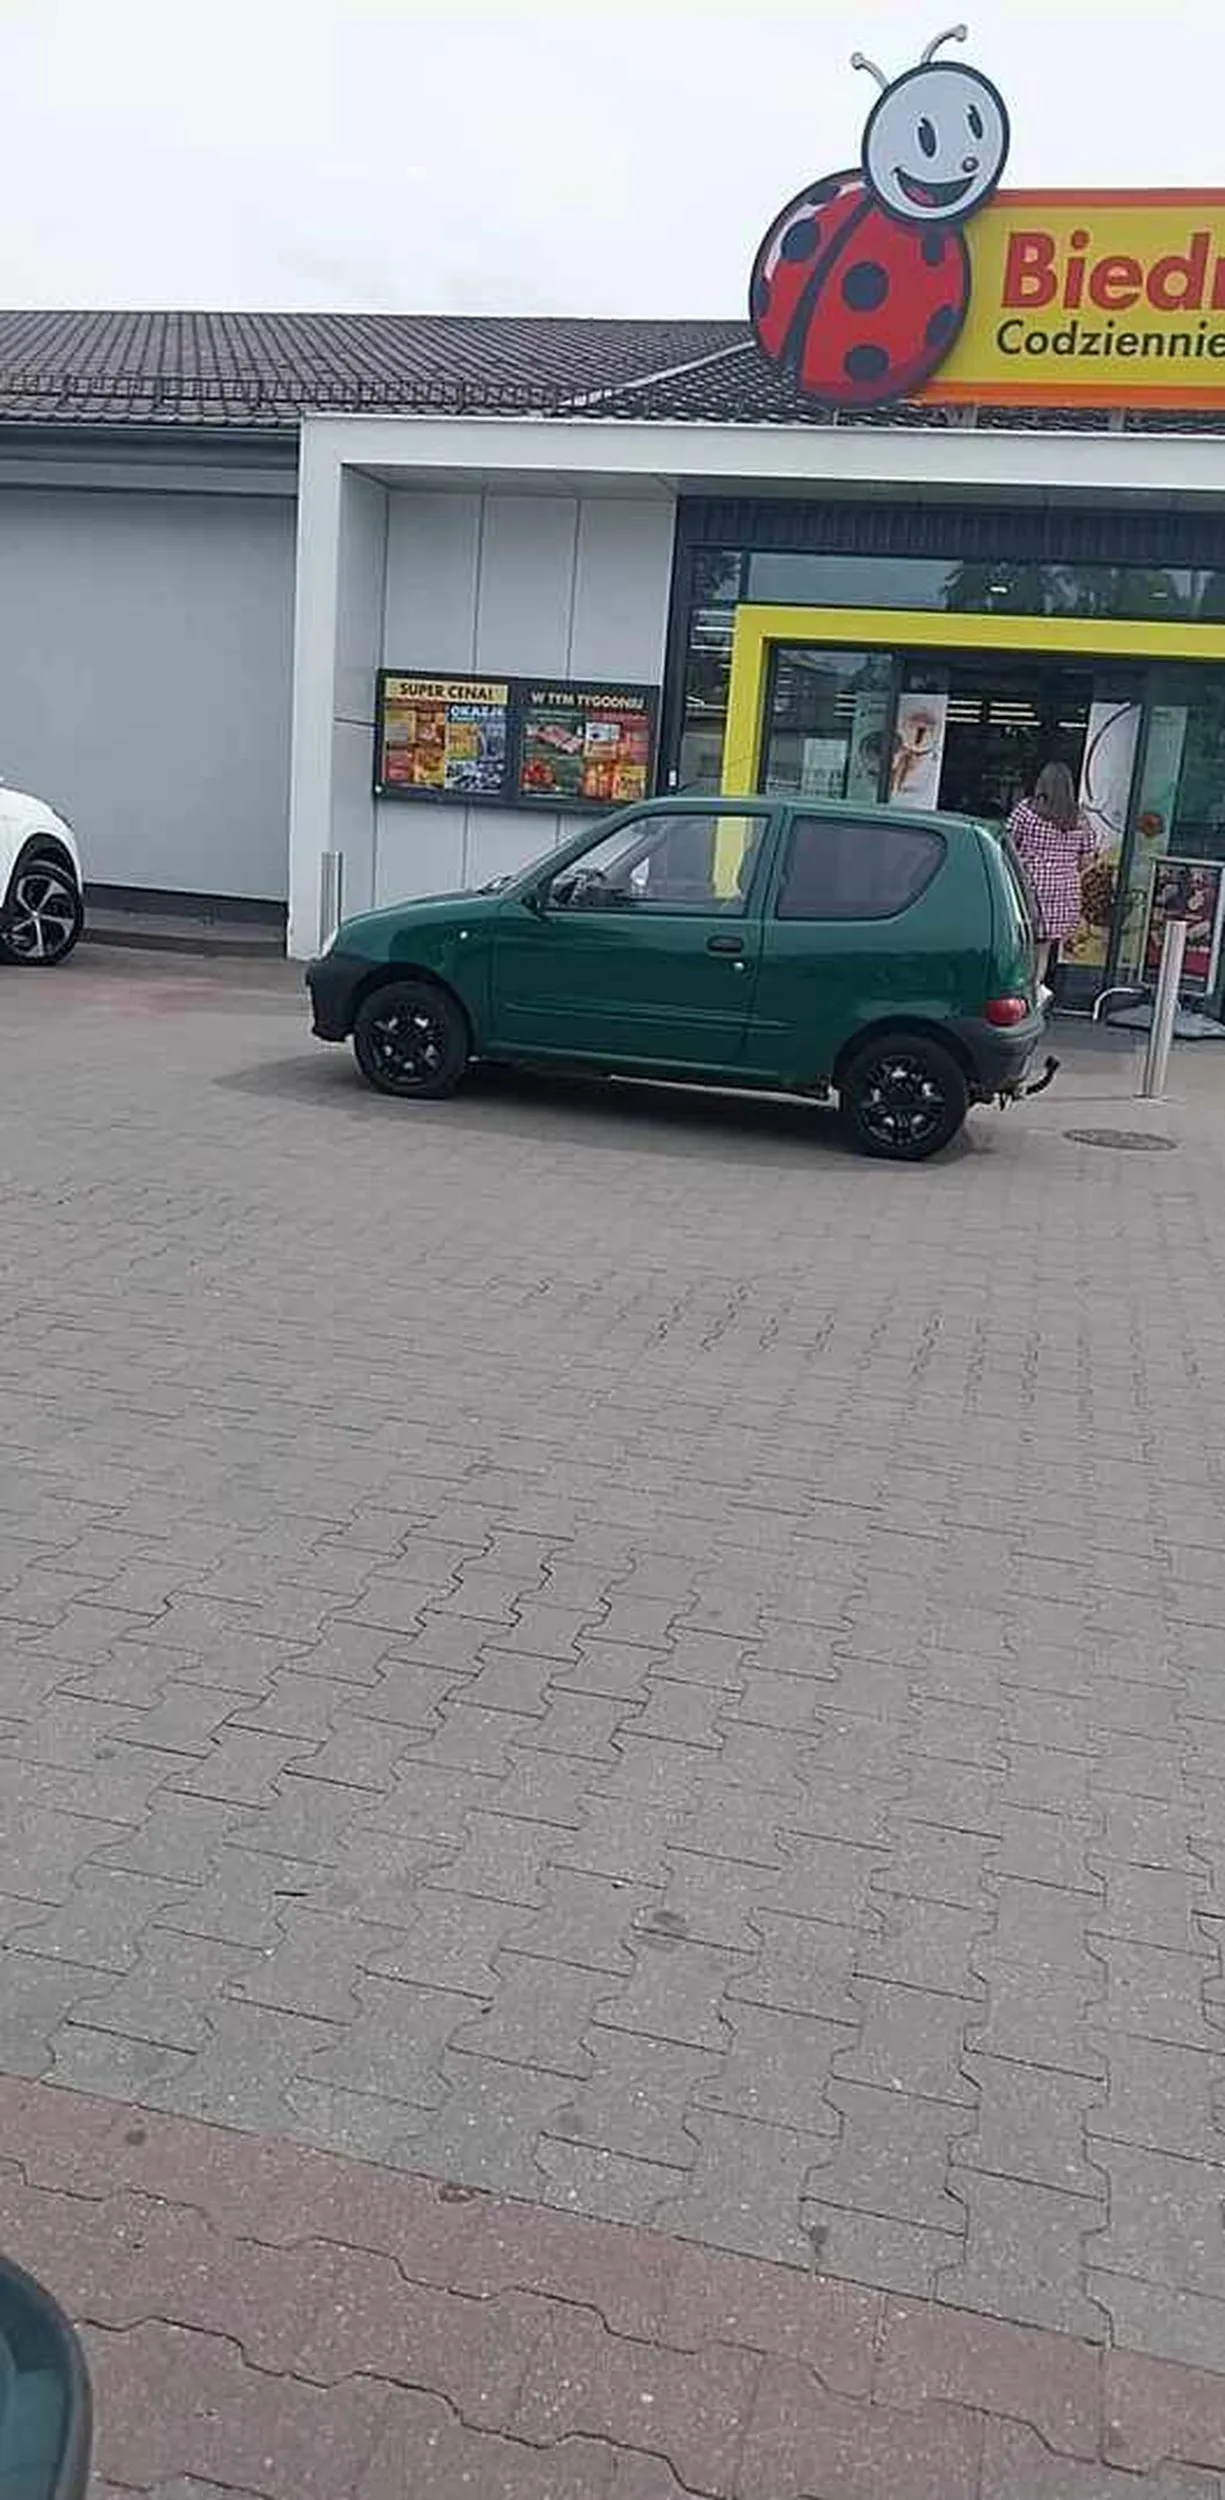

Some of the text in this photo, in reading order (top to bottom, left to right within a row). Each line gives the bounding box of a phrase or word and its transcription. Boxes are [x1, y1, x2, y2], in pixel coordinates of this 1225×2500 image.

[997, 318, 1225, 357] Codziennie
[400, 682, 494, 701] SUPER CENA!
[531, 691, 547, 705] W
[548, 692, 575, 706] TYM
